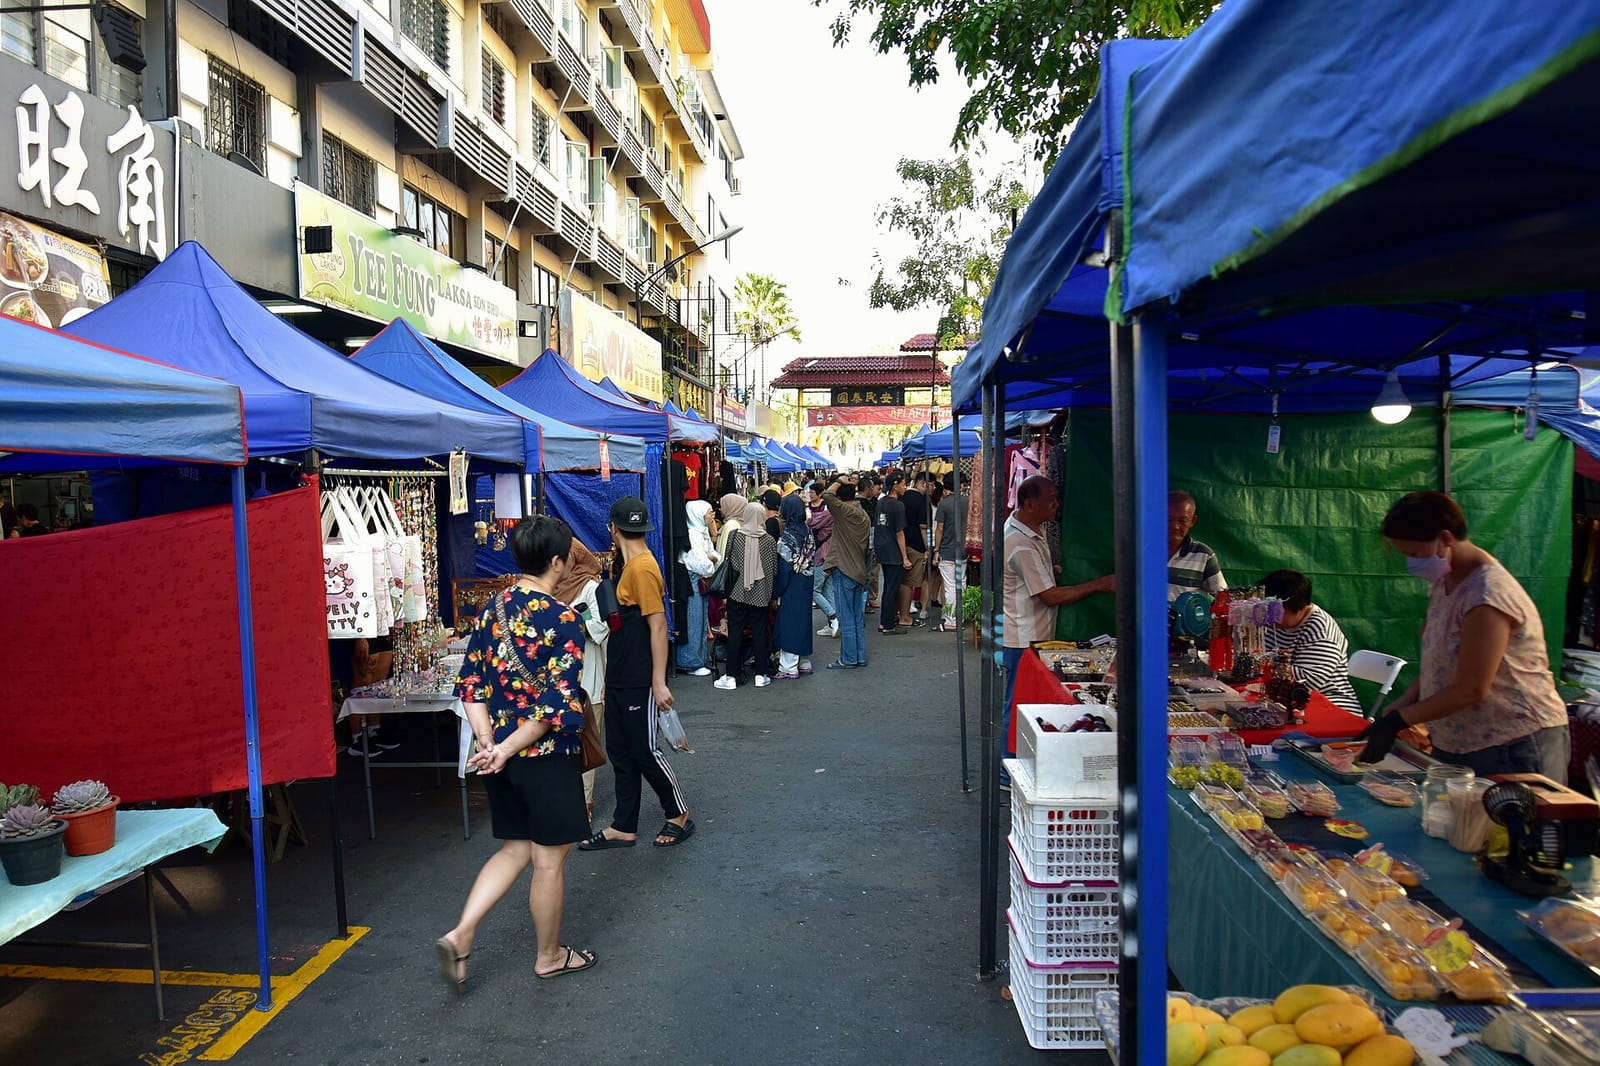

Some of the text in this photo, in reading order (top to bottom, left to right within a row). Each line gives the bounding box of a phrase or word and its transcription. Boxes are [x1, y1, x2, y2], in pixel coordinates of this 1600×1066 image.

[15, 83, 167, 263] 旺角
[347, 232, 388, 304] YEE
[391, 252, 436, 318] FUNG
[437, 274, 473, 310] LAKSA
